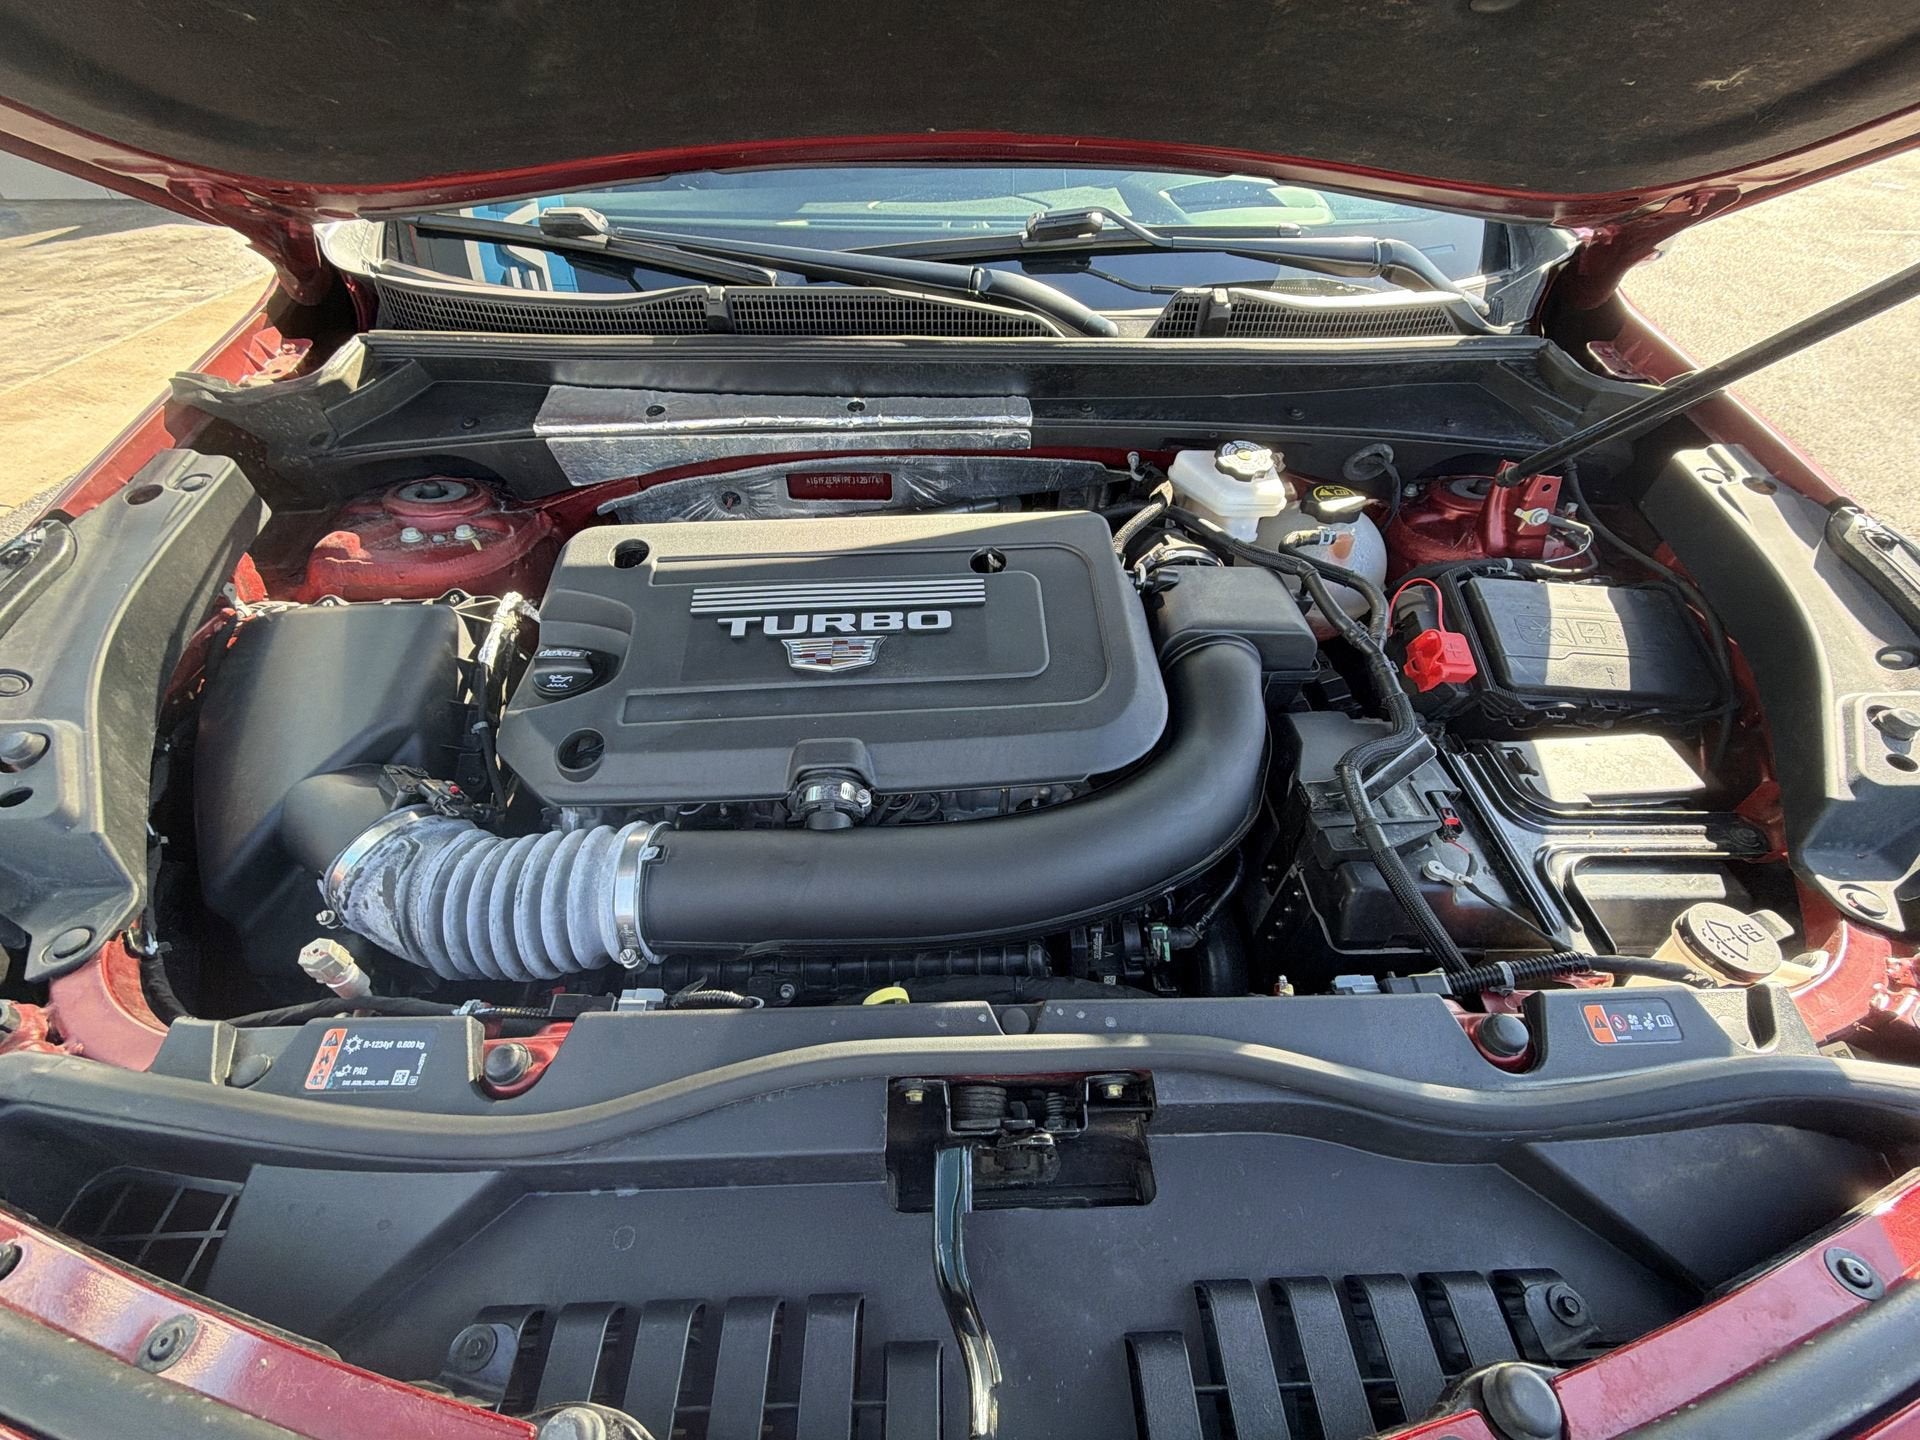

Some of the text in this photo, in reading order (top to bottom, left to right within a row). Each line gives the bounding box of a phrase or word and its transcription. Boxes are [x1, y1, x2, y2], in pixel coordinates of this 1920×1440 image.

[717, 610, 952, 638] TURBO
[539, 649, 584, 657] dexos
[363, 1040, 394, 1050] R-1234yf
[352, 1066, 368, 1076] PAG
